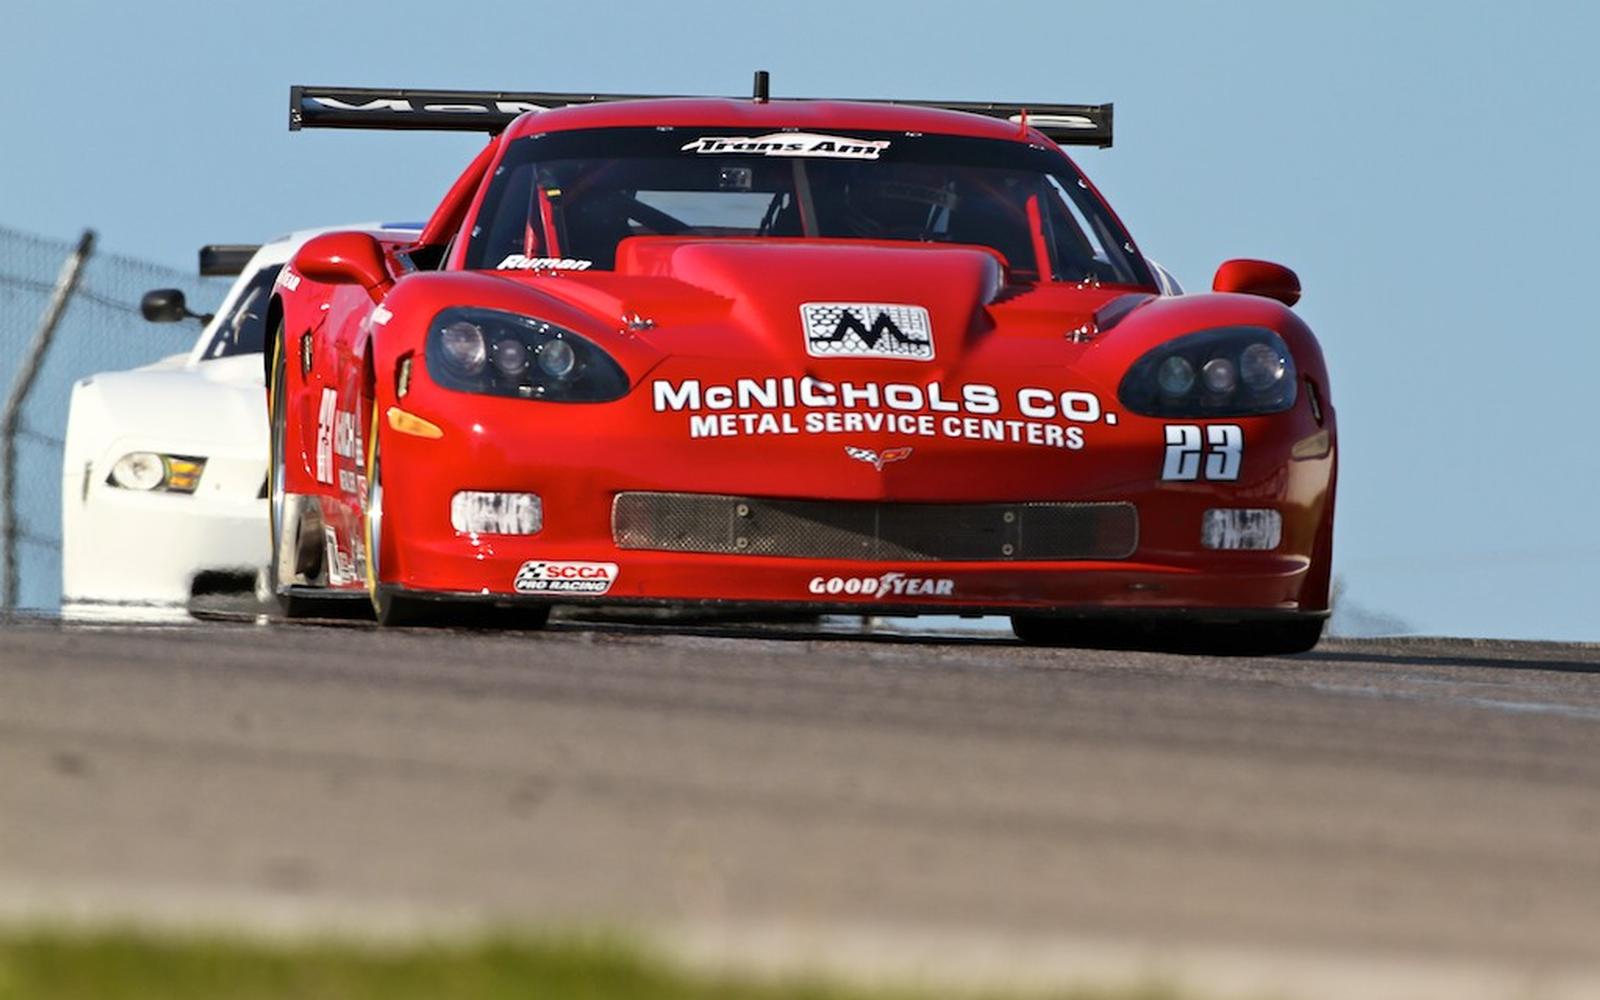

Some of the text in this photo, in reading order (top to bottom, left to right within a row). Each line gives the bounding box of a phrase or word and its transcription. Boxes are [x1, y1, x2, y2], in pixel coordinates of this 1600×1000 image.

[701, 139, 877, 155] Trans Am
[497, 254, 592, 271] Ruman
[653, 378, 1118, 425] McNICHOLS CO.
[690, 413, 1085, 450] METAL SERVICE CENTERS
[1161, 424, 1244, 482] 23
[546, 566, 609, 578] SCCA
[517, 581, 606, 591] PRO RACING
[808, 573, 954, 599] GOODYEAR
